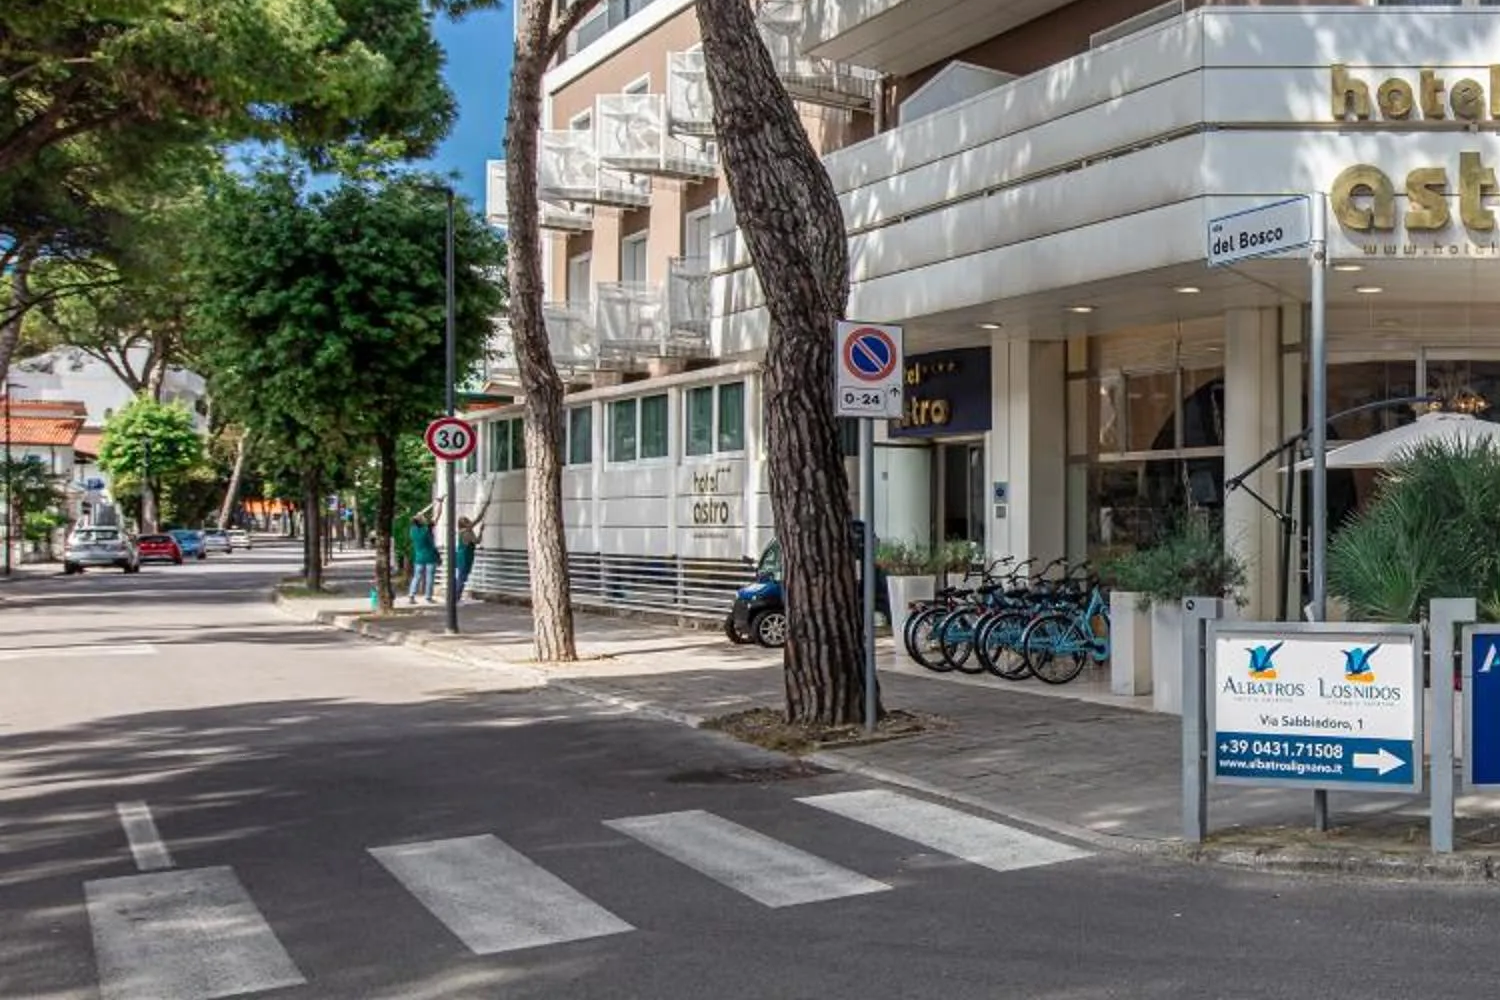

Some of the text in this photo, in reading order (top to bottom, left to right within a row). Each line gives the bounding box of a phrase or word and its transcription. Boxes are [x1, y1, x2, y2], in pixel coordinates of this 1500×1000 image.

[1213, 227, 1283, 255] del Bosco
[439, 430, 465, 448] 30
[694, 471, 719, 493] hotel
[694, 498, 728, 524] astro
[1223, 675, 1305, 697] ALBATROS
[1259, 714, 1278, 727] Via
[1357, 719, 1364, 730] 1
[1219, 740, 1344, 759] +39 0431.71508
